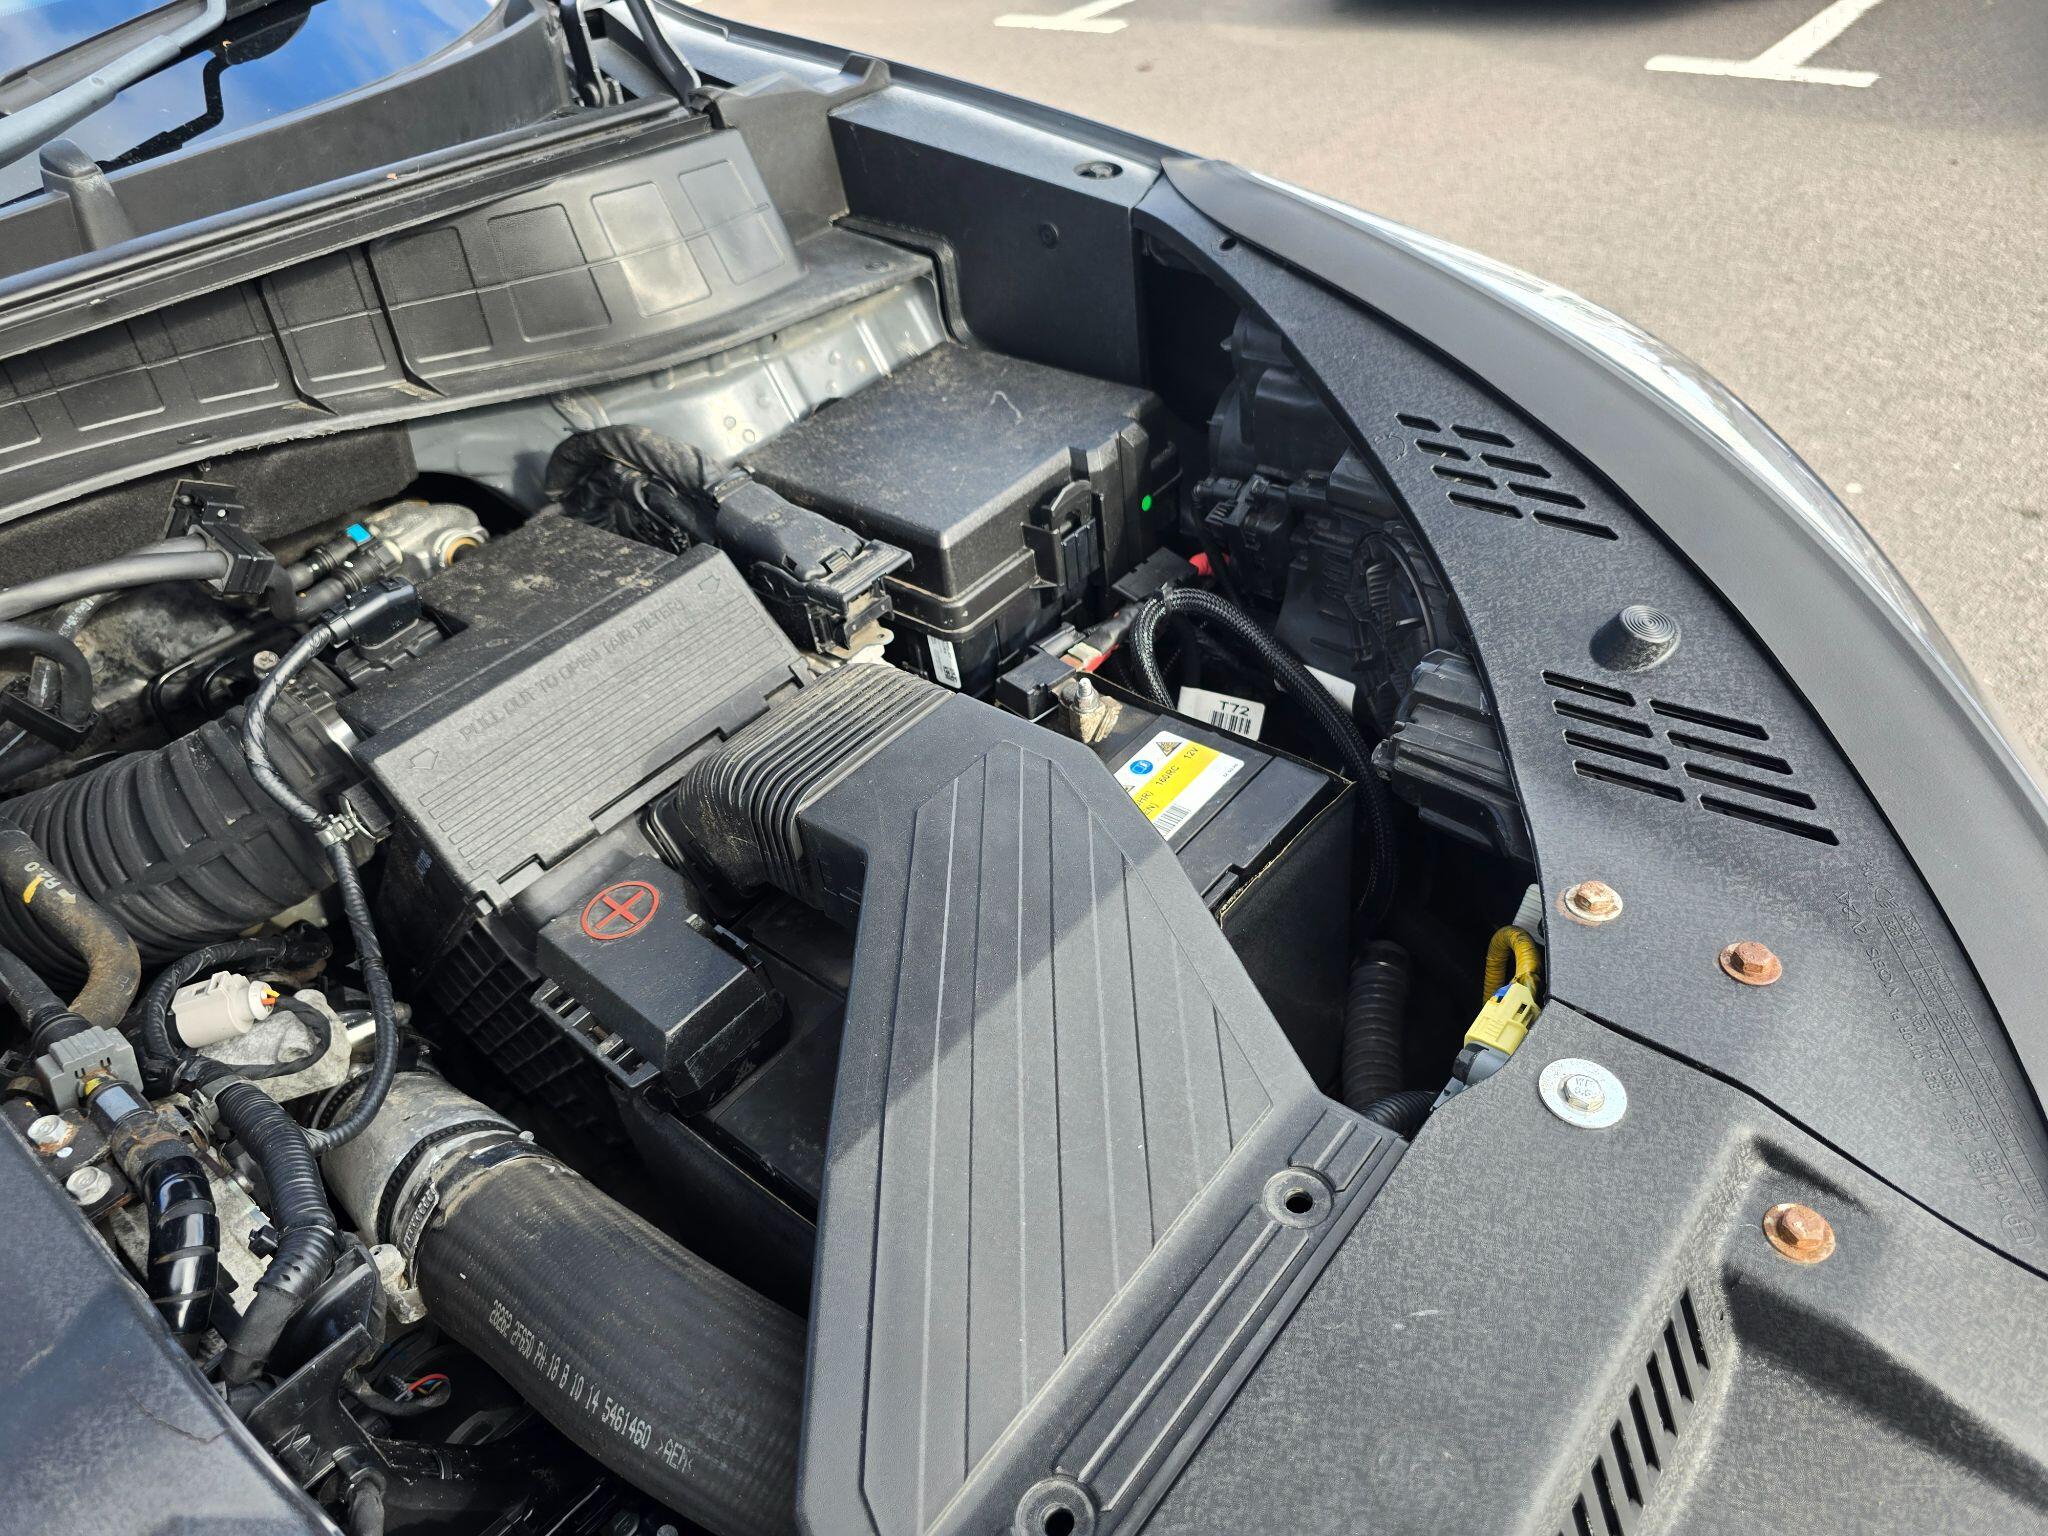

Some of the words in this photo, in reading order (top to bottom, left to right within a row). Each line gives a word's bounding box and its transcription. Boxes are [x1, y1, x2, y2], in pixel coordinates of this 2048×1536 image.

[1219, 700, 1250, 717] T72
[1183, 747, 1199, 760] 12V
[569, 1372, 585, 1401] 10
[585, 1384, 601, 1414] 14
[601, 1396, 652, 1450] 5461460
